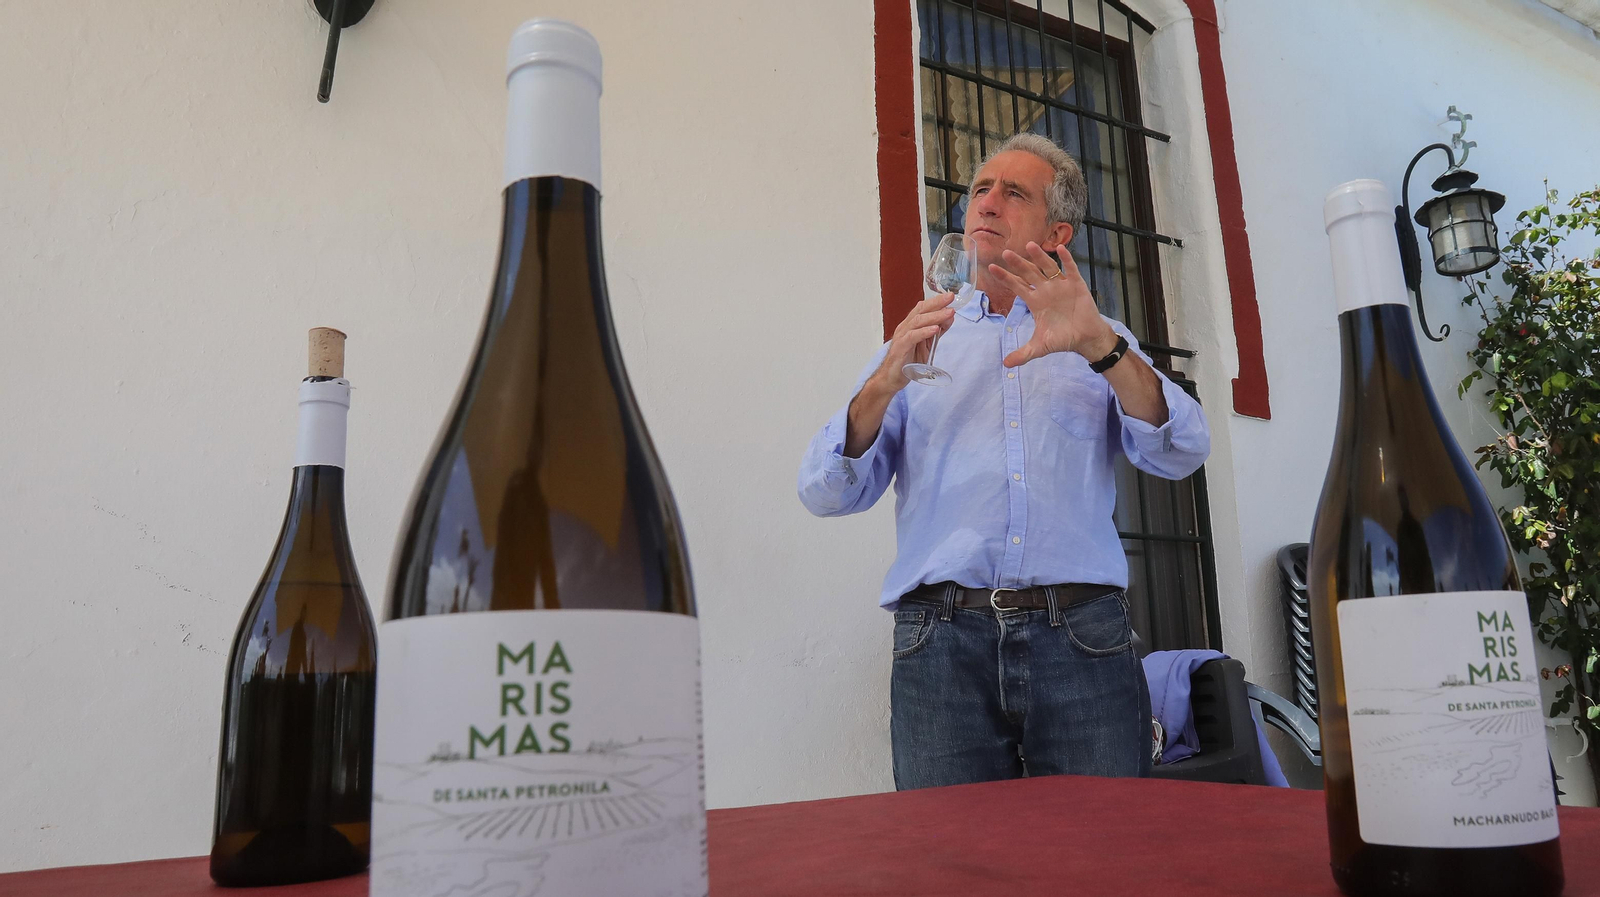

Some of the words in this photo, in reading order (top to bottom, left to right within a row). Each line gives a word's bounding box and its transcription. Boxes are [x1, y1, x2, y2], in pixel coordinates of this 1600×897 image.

[1477, 610, 1515, 632] MA
[496, 640, 573, 676] MA
[1483, 636, 1518, 658] RIS
[1467, 661, 1521, 686] MAS
[500, 681, 572, 716] RIS
[1448, 703, 1463, 712] DE
[1465, 702, 1499, 711] SANTA
[468, 722, 572, 760] MAS
[433, 788, 453, 802] DE
[456, 786, 510, 801] SANTA
[514, 781, 611, 798] PETRONILA
[1453, 811, 1540, 827] MACHARNUDO
